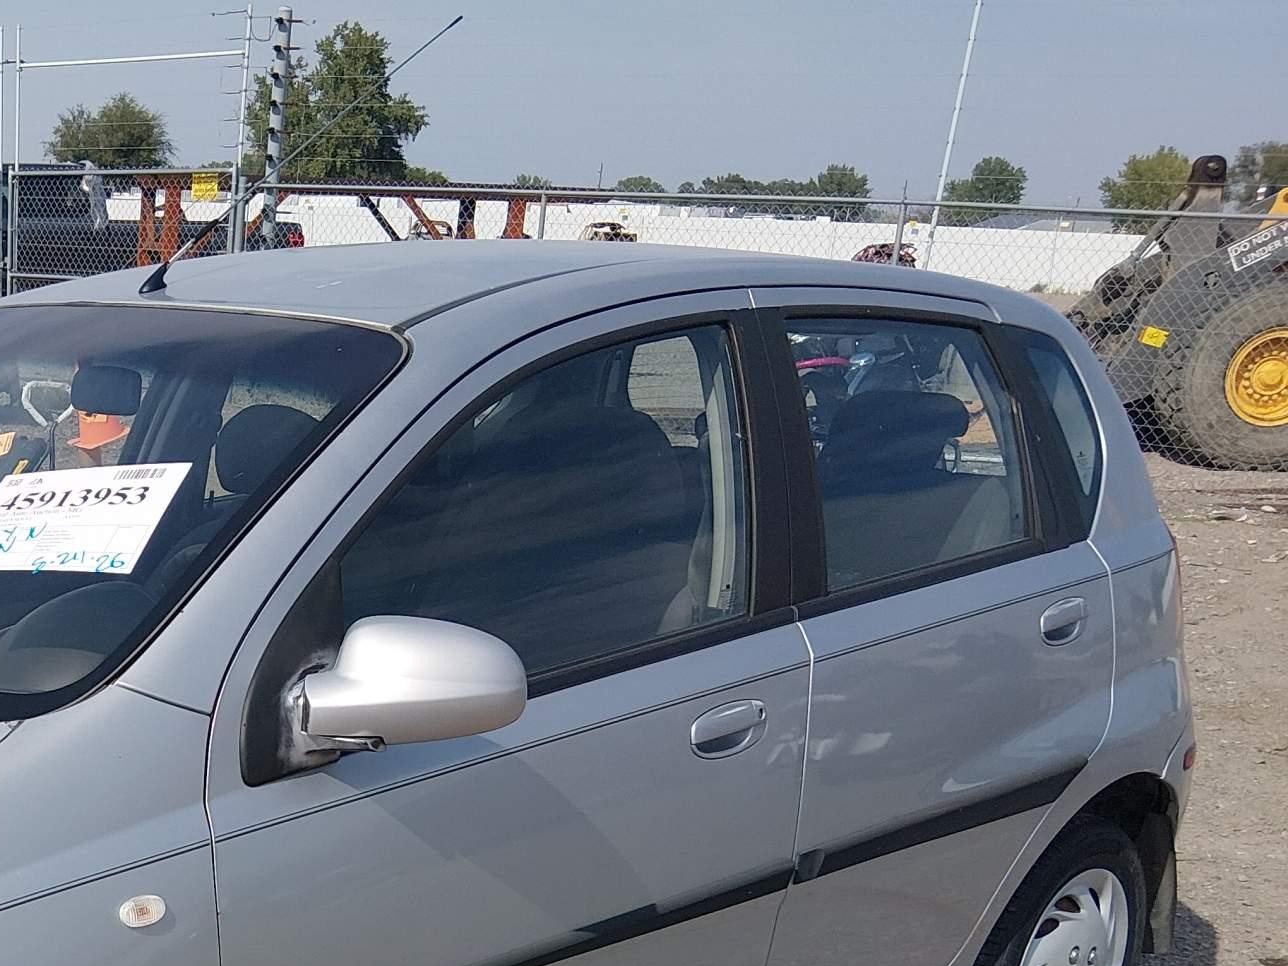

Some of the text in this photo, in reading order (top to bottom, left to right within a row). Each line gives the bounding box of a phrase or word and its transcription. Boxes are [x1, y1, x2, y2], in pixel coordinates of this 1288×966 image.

[1231, 242, 1250, 257] DO
[1252, 229, 1278, 246] NOT
[1242, 240, 1283, 264] UNDER
[0, 486, 150, 511] 45913953
